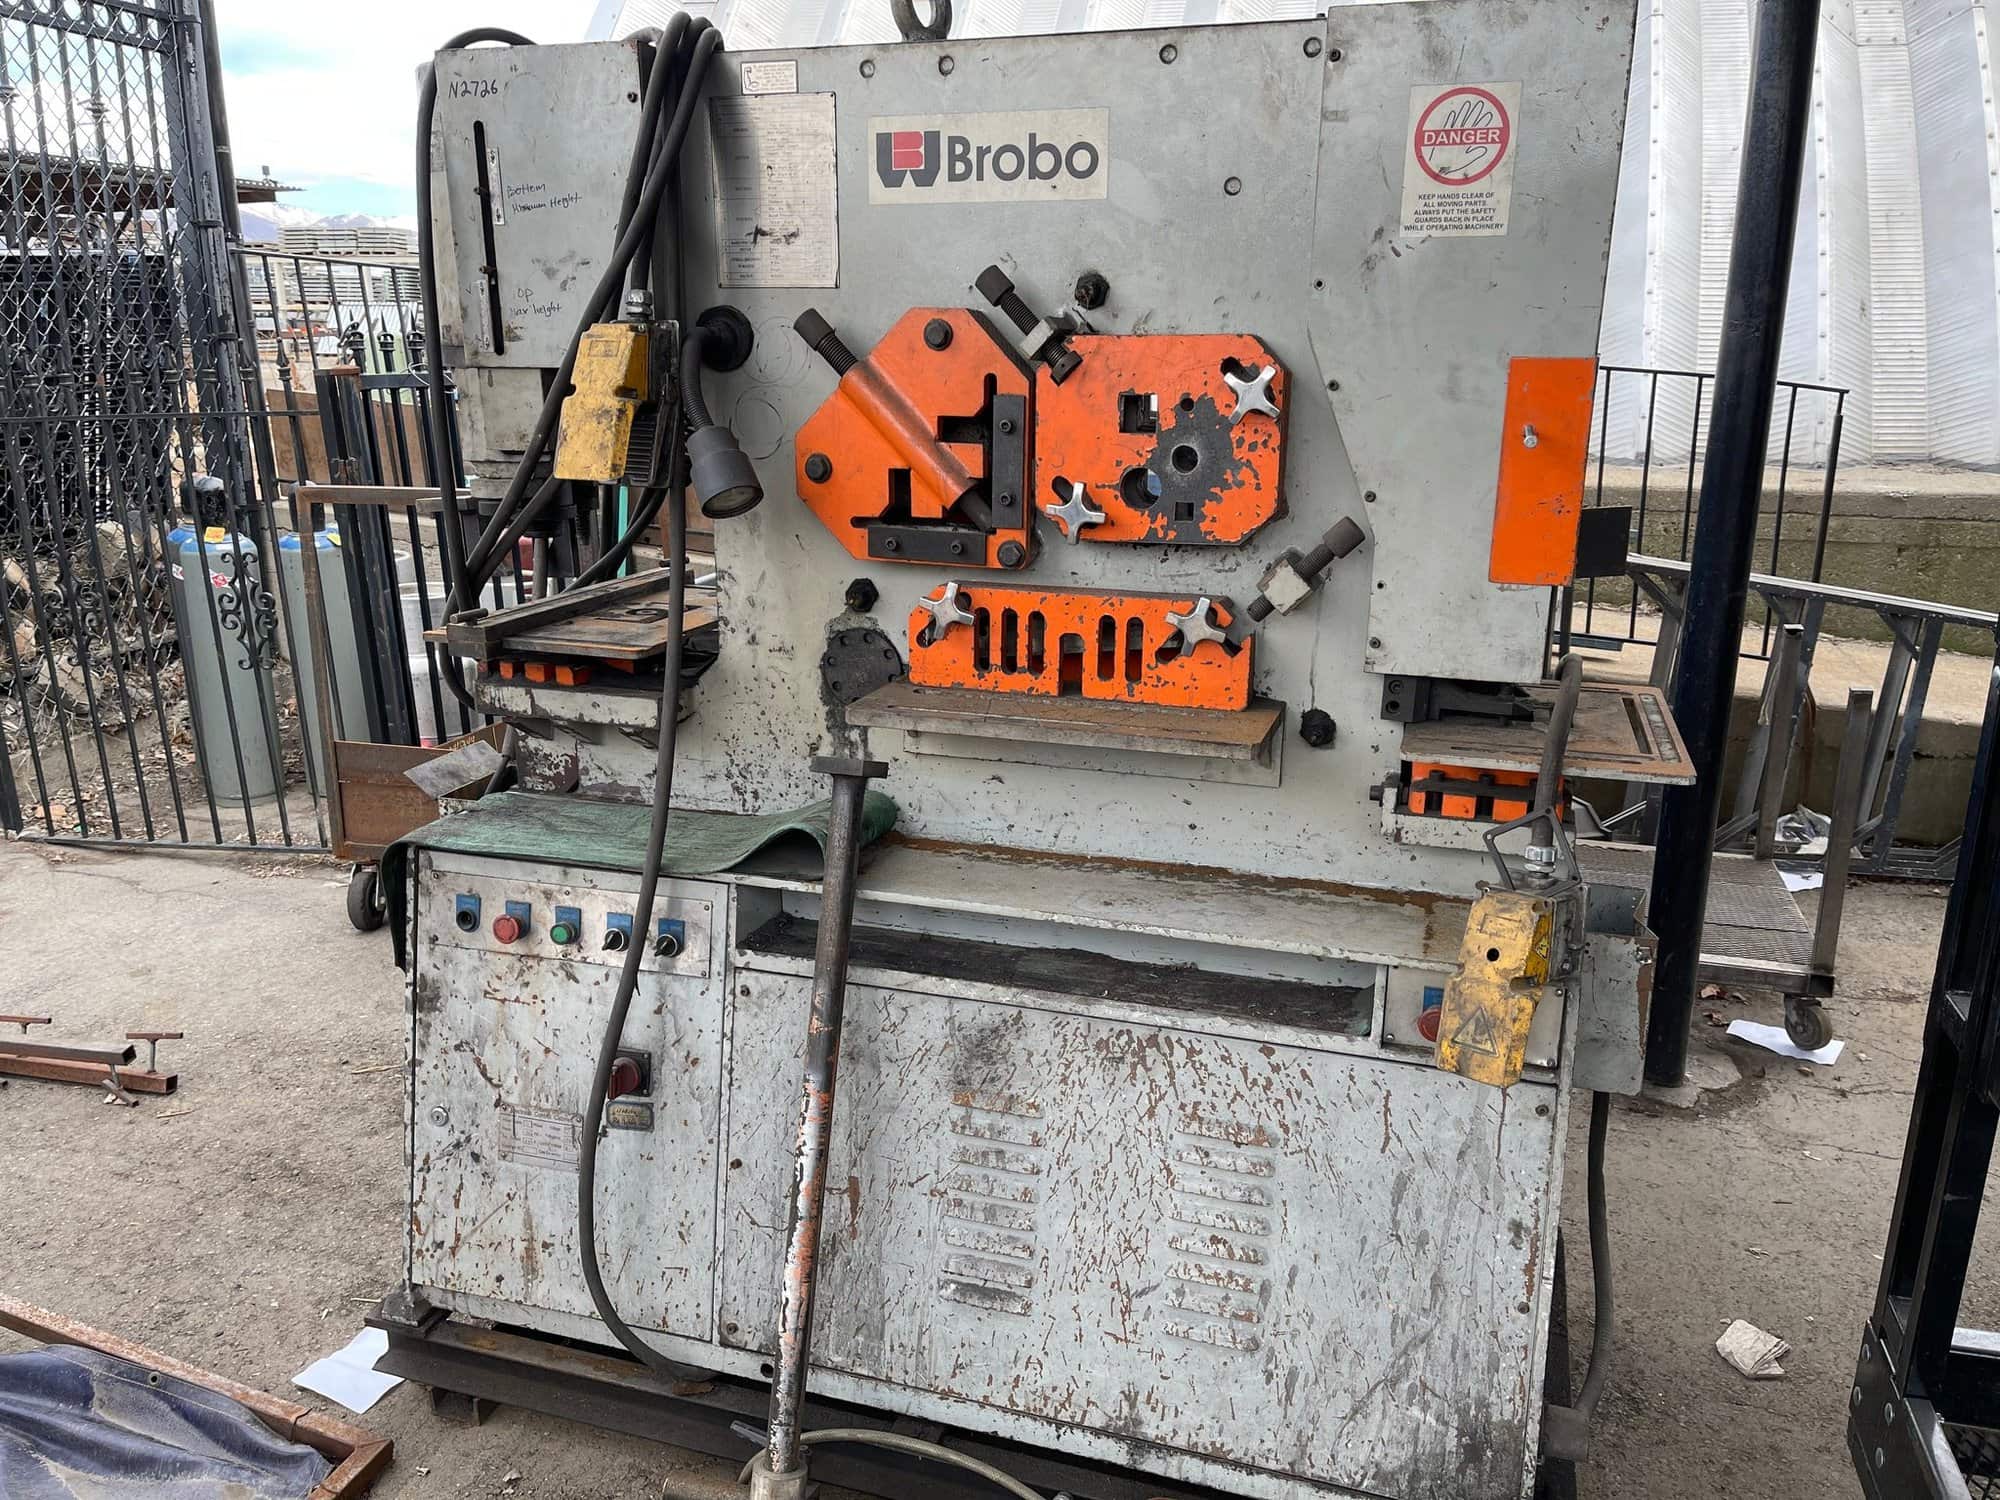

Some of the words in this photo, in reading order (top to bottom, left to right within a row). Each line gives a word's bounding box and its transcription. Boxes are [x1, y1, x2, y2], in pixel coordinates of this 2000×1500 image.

[448, 79, 499, 99] N2726
[1424, 129, 1500, 145] DANGER
[947, 132, 1100, 183] Brobo
